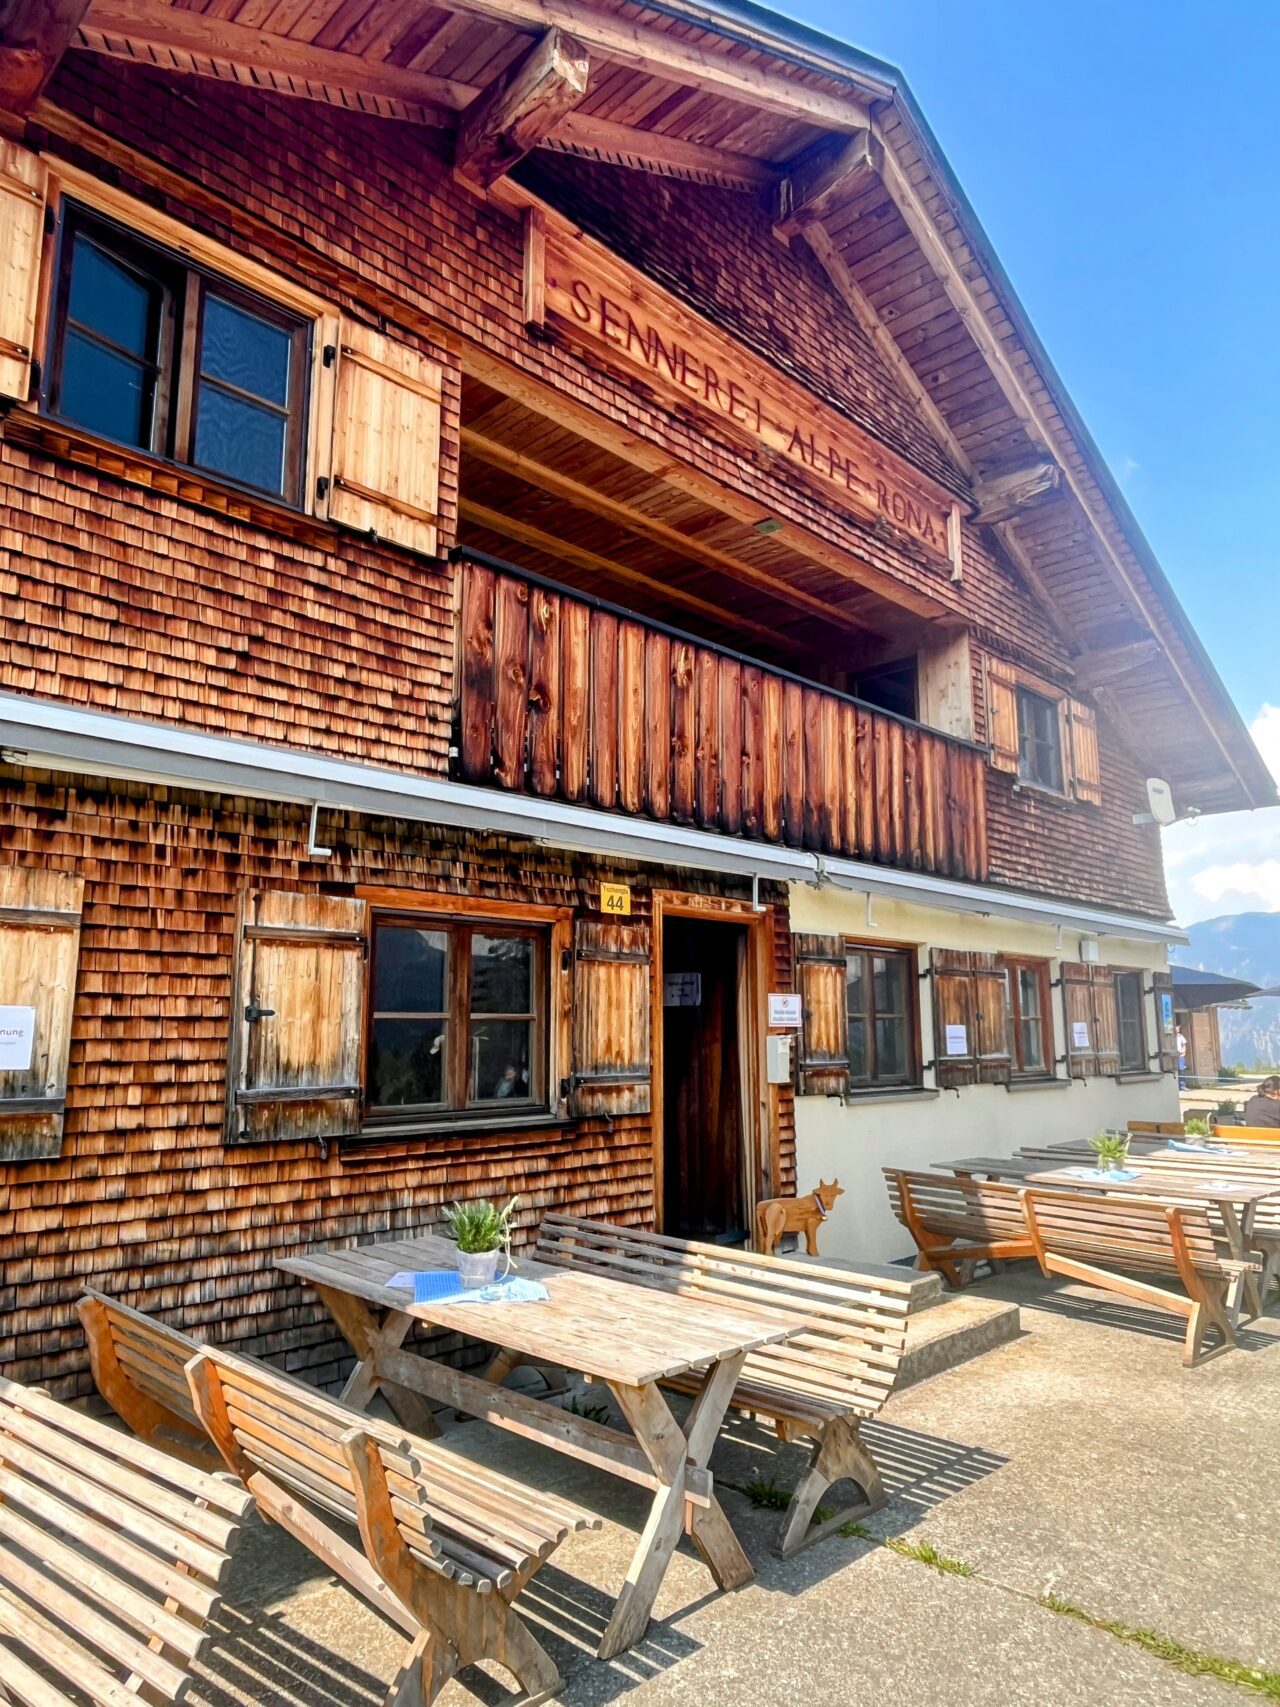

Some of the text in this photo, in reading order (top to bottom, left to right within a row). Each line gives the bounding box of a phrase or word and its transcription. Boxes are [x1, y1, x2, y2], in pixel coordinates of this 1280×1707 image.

[570, 280, 937, 545] SENNEREI ALPE RONA
[606, 895, 624, 911] 44
